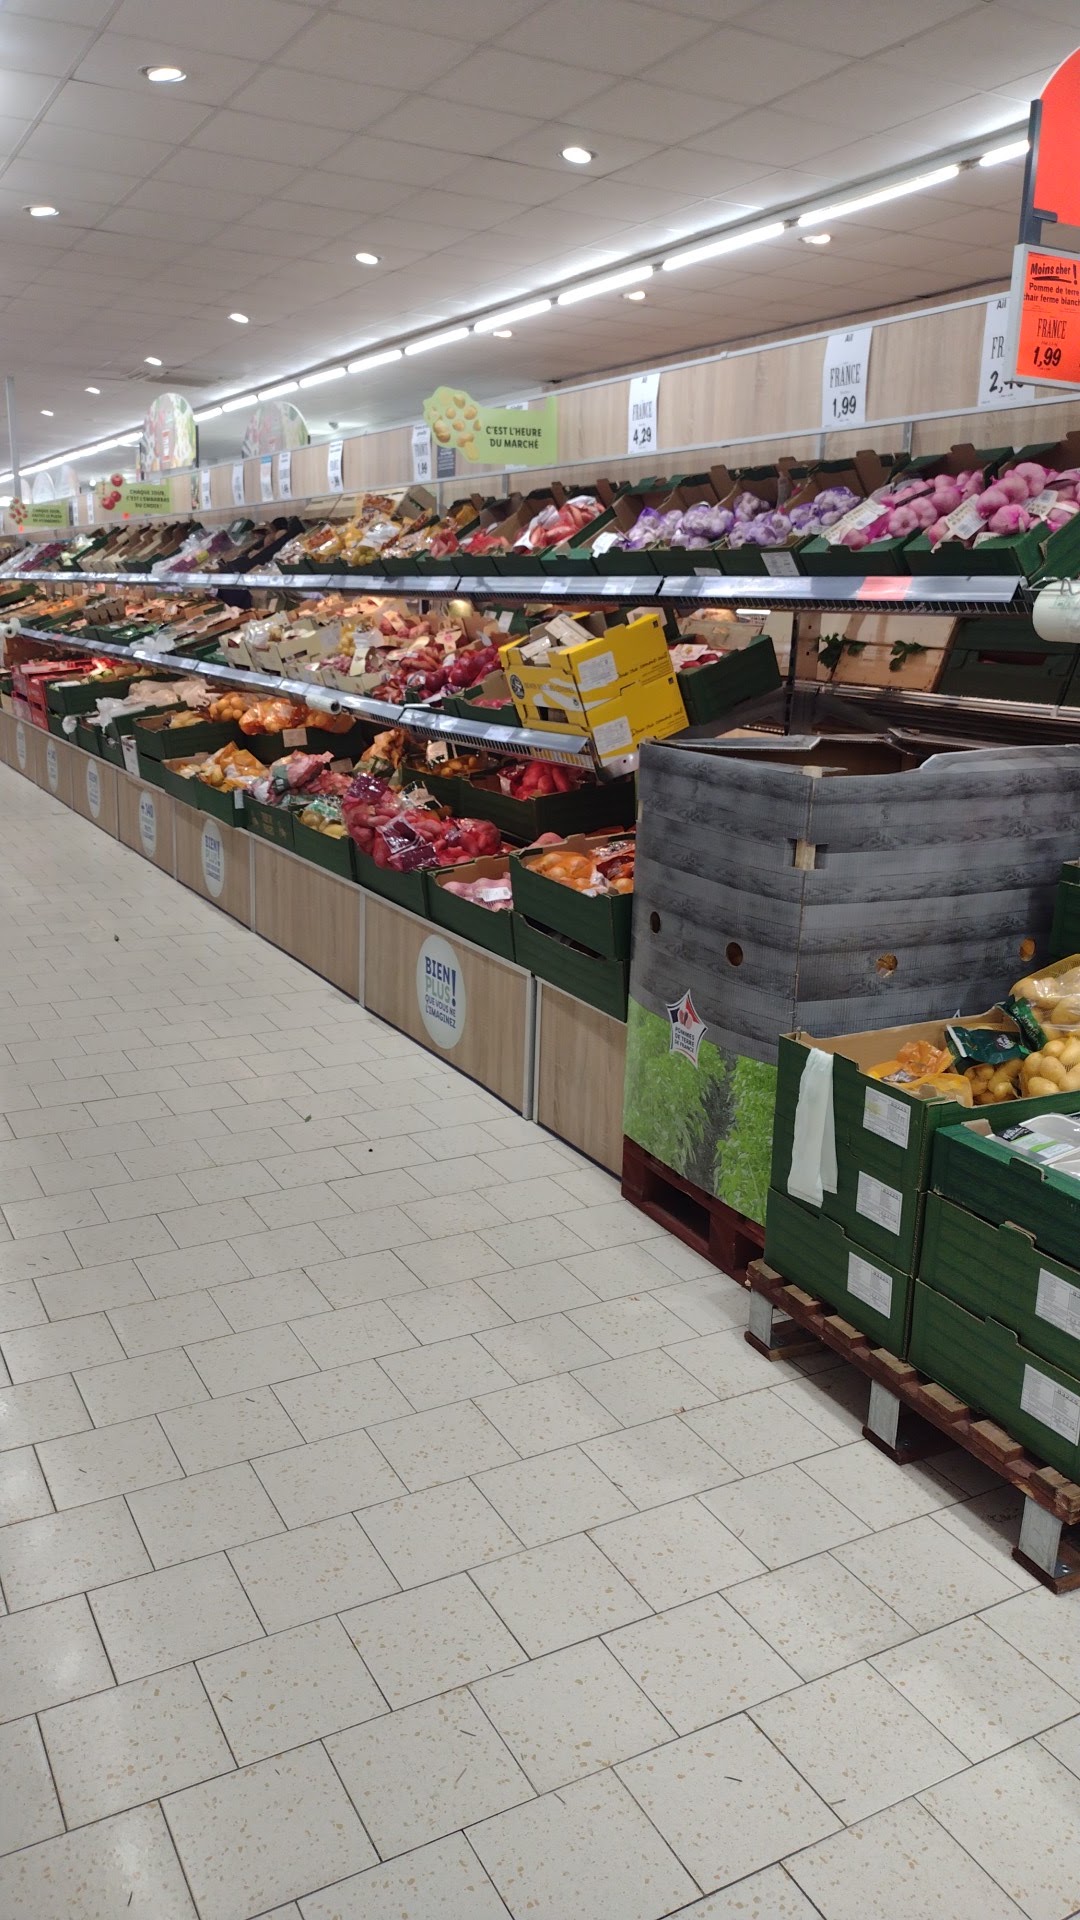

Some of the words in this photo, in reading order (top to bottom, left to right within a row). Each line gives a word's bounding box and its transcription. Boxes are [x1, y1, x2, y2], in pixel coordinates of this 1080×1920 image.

[1030, 263, 1054, 275] Moins
[1055, 264, 1071, 275] cher
[1029, 282, 1053, 293] Pomme
[1055, 285, 1063, 295] de
[1065, 287, 1079, 296] terre
[1040, 294, 1059, 304] ferme
[1060, 297, 1080, 306] blanch
[1037, 318, 1067, 339] FRANCE
[1033, 346, 1062, 367] 1,99
[829, 363, 861, 388] FRANCE
[832, 395, 857, 418] 1,99
[486, 425, 508, 435] C'EST
[509, 427, 542, 437] L'HEURE
[633, 426, 652, 446] 4,29
[489, 438, 502, 447] DU
[504, 439, 539, 449] MARCHÉ
[425, 956, 450, 985] BIEN
[425, 975, 450, 1004] PLUS
[425, 994, 435, 1005] QUE
[435, 999, 448, 1013] VOUS
[449, 1005, 456, 1017] NE
